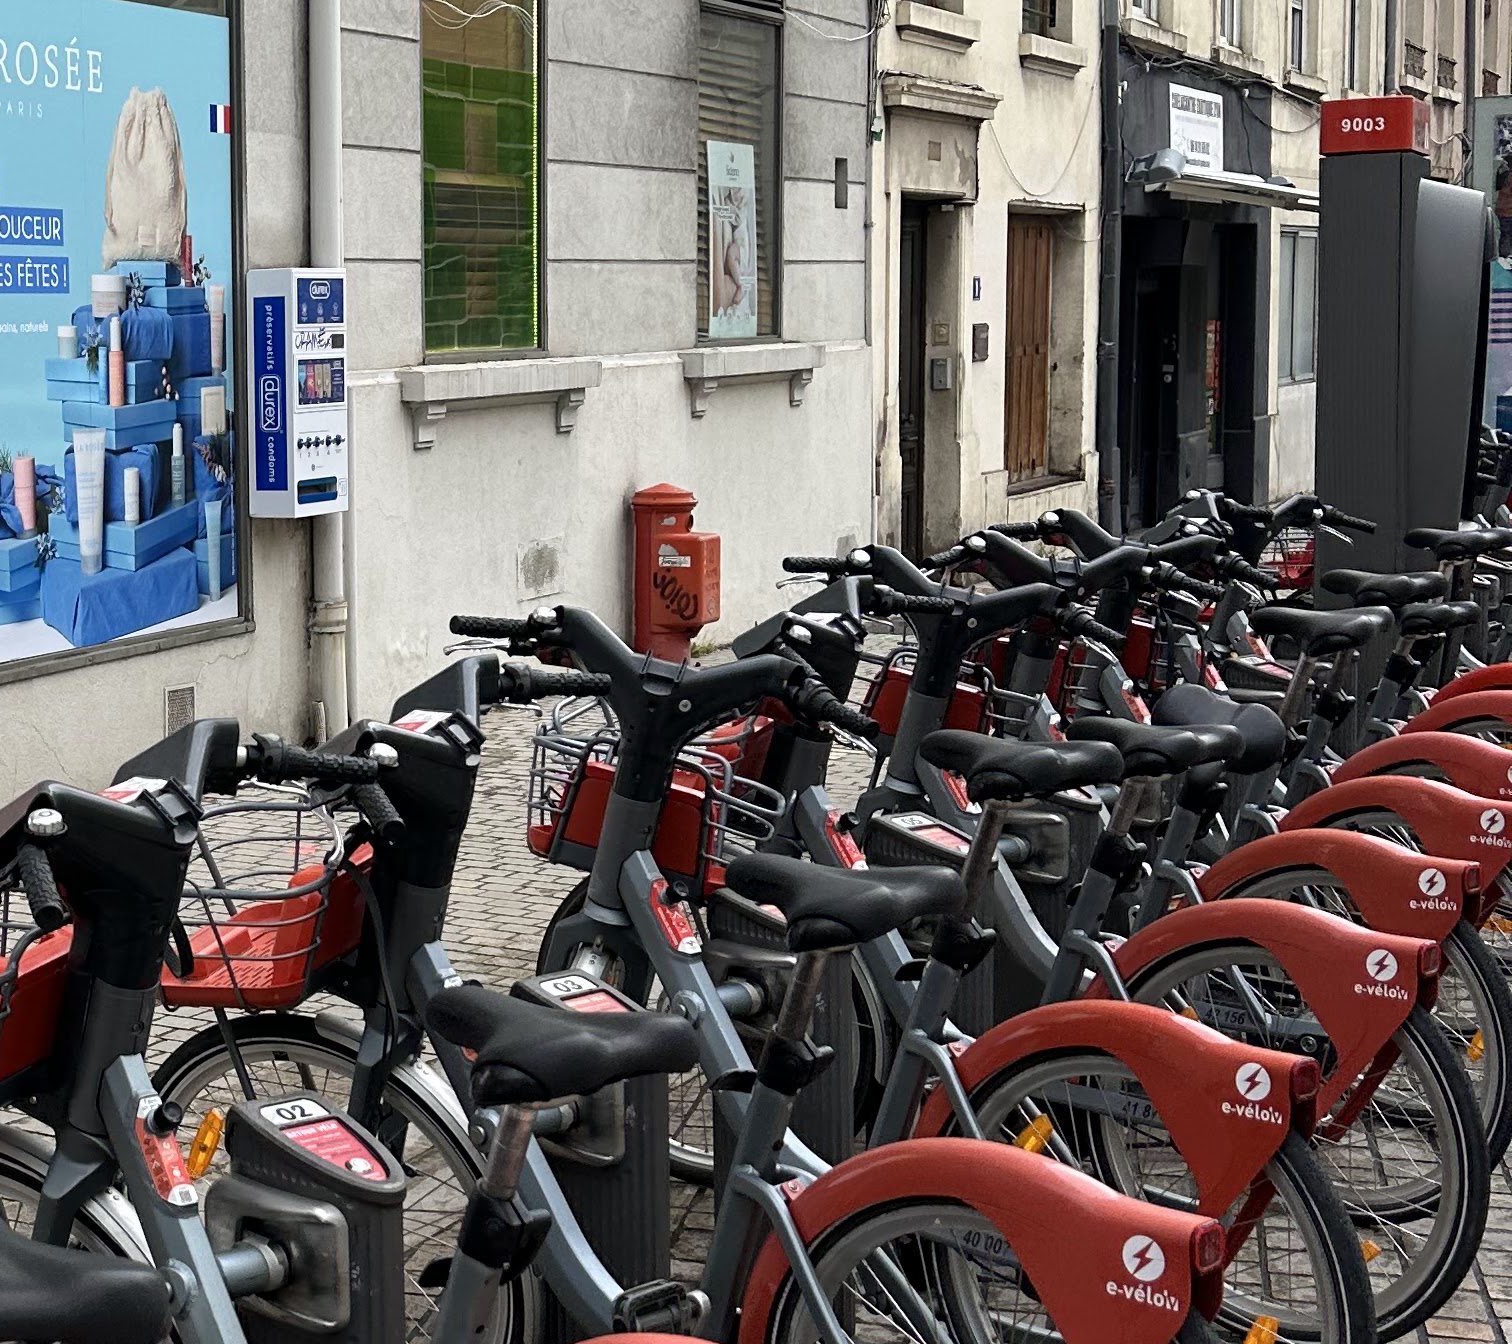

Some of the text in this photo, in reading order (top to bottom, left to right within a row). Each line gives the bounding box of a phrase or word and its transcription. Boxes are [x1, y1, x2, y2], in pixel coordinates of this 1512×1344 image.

[1341, 116, 1386, 133] 9003
[17, 258, 60, 288] FÊTES
[264, 379, 281, 427] durex
[266, 436, 276, 483] condoms
[553, 979, 583, 993] 03
[275, 1104, 314, 1121] 02
